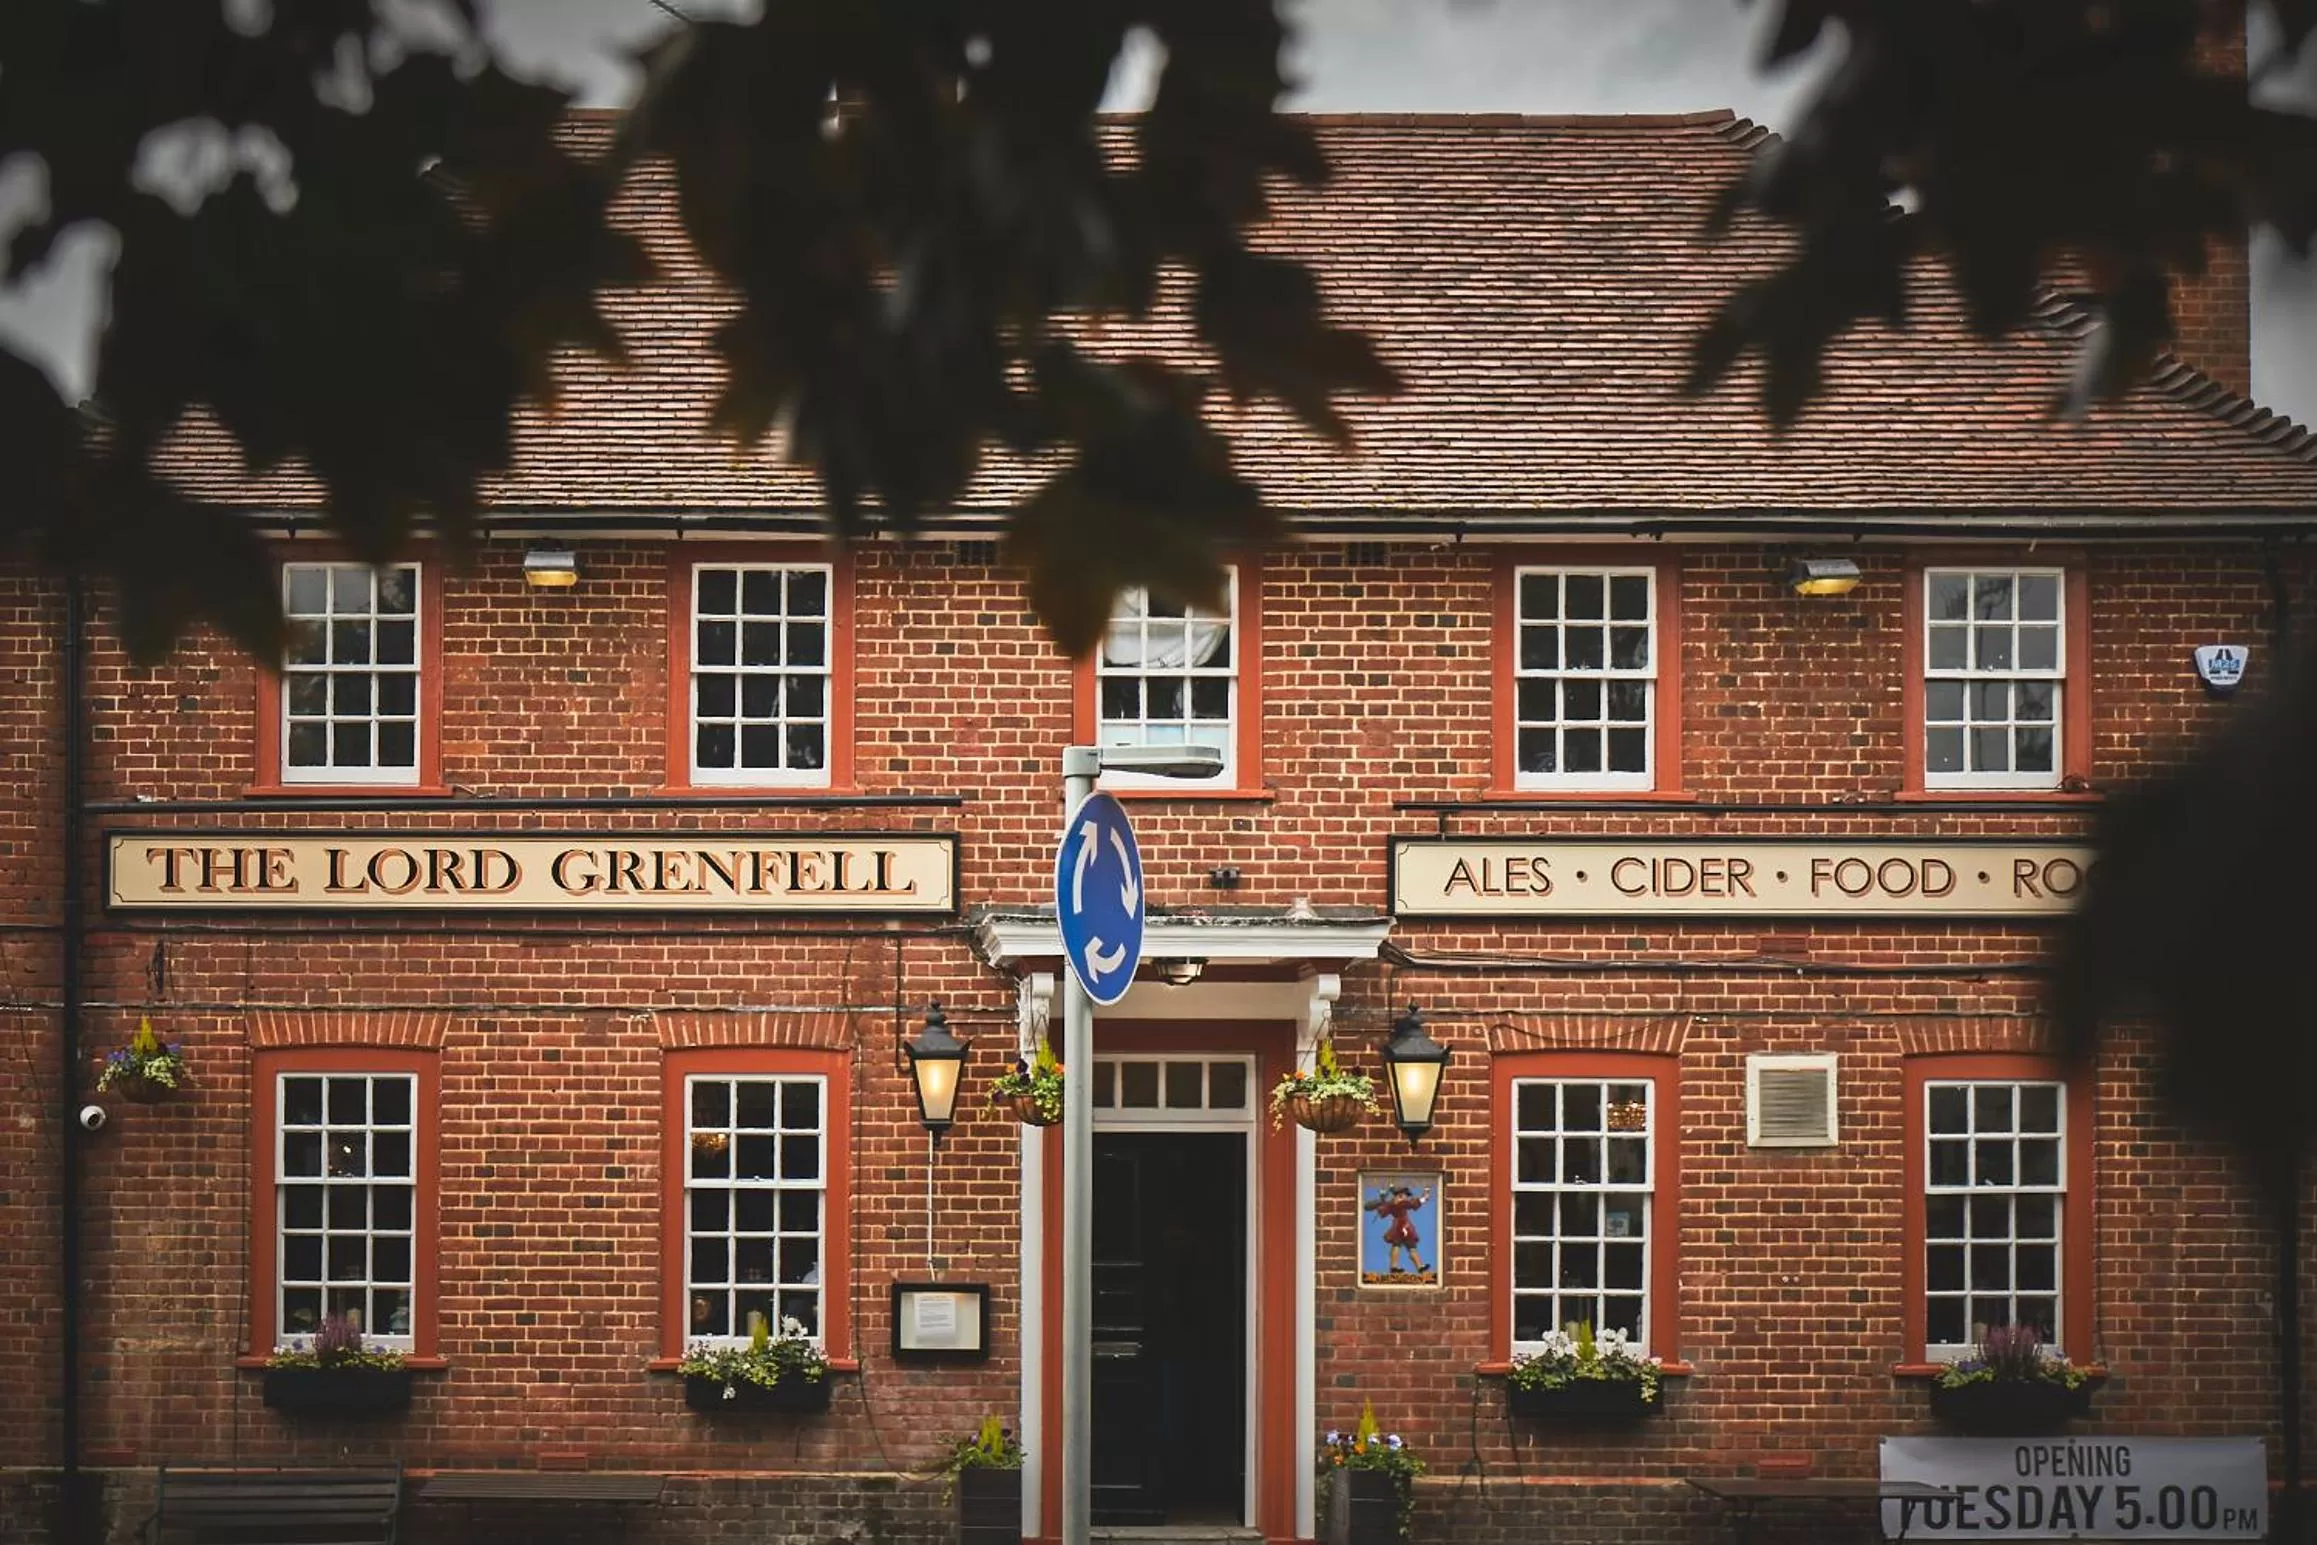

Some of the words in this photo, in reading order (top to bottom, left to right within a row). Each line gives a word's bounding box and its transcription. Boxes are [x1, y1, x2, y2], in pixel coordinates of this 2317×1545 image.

[146, 847, 299, 893] THE
[323, 848, 523, 895] LORD
[551, 849, 917, 896] GRENFELL
[1443, 857, 1553, 897] ALES
[1610, 857, 1757, 897] CIDER
[1810, 857, 1957, 898] FOOD
[2015, 1445, 2131, 1477] OPENING
